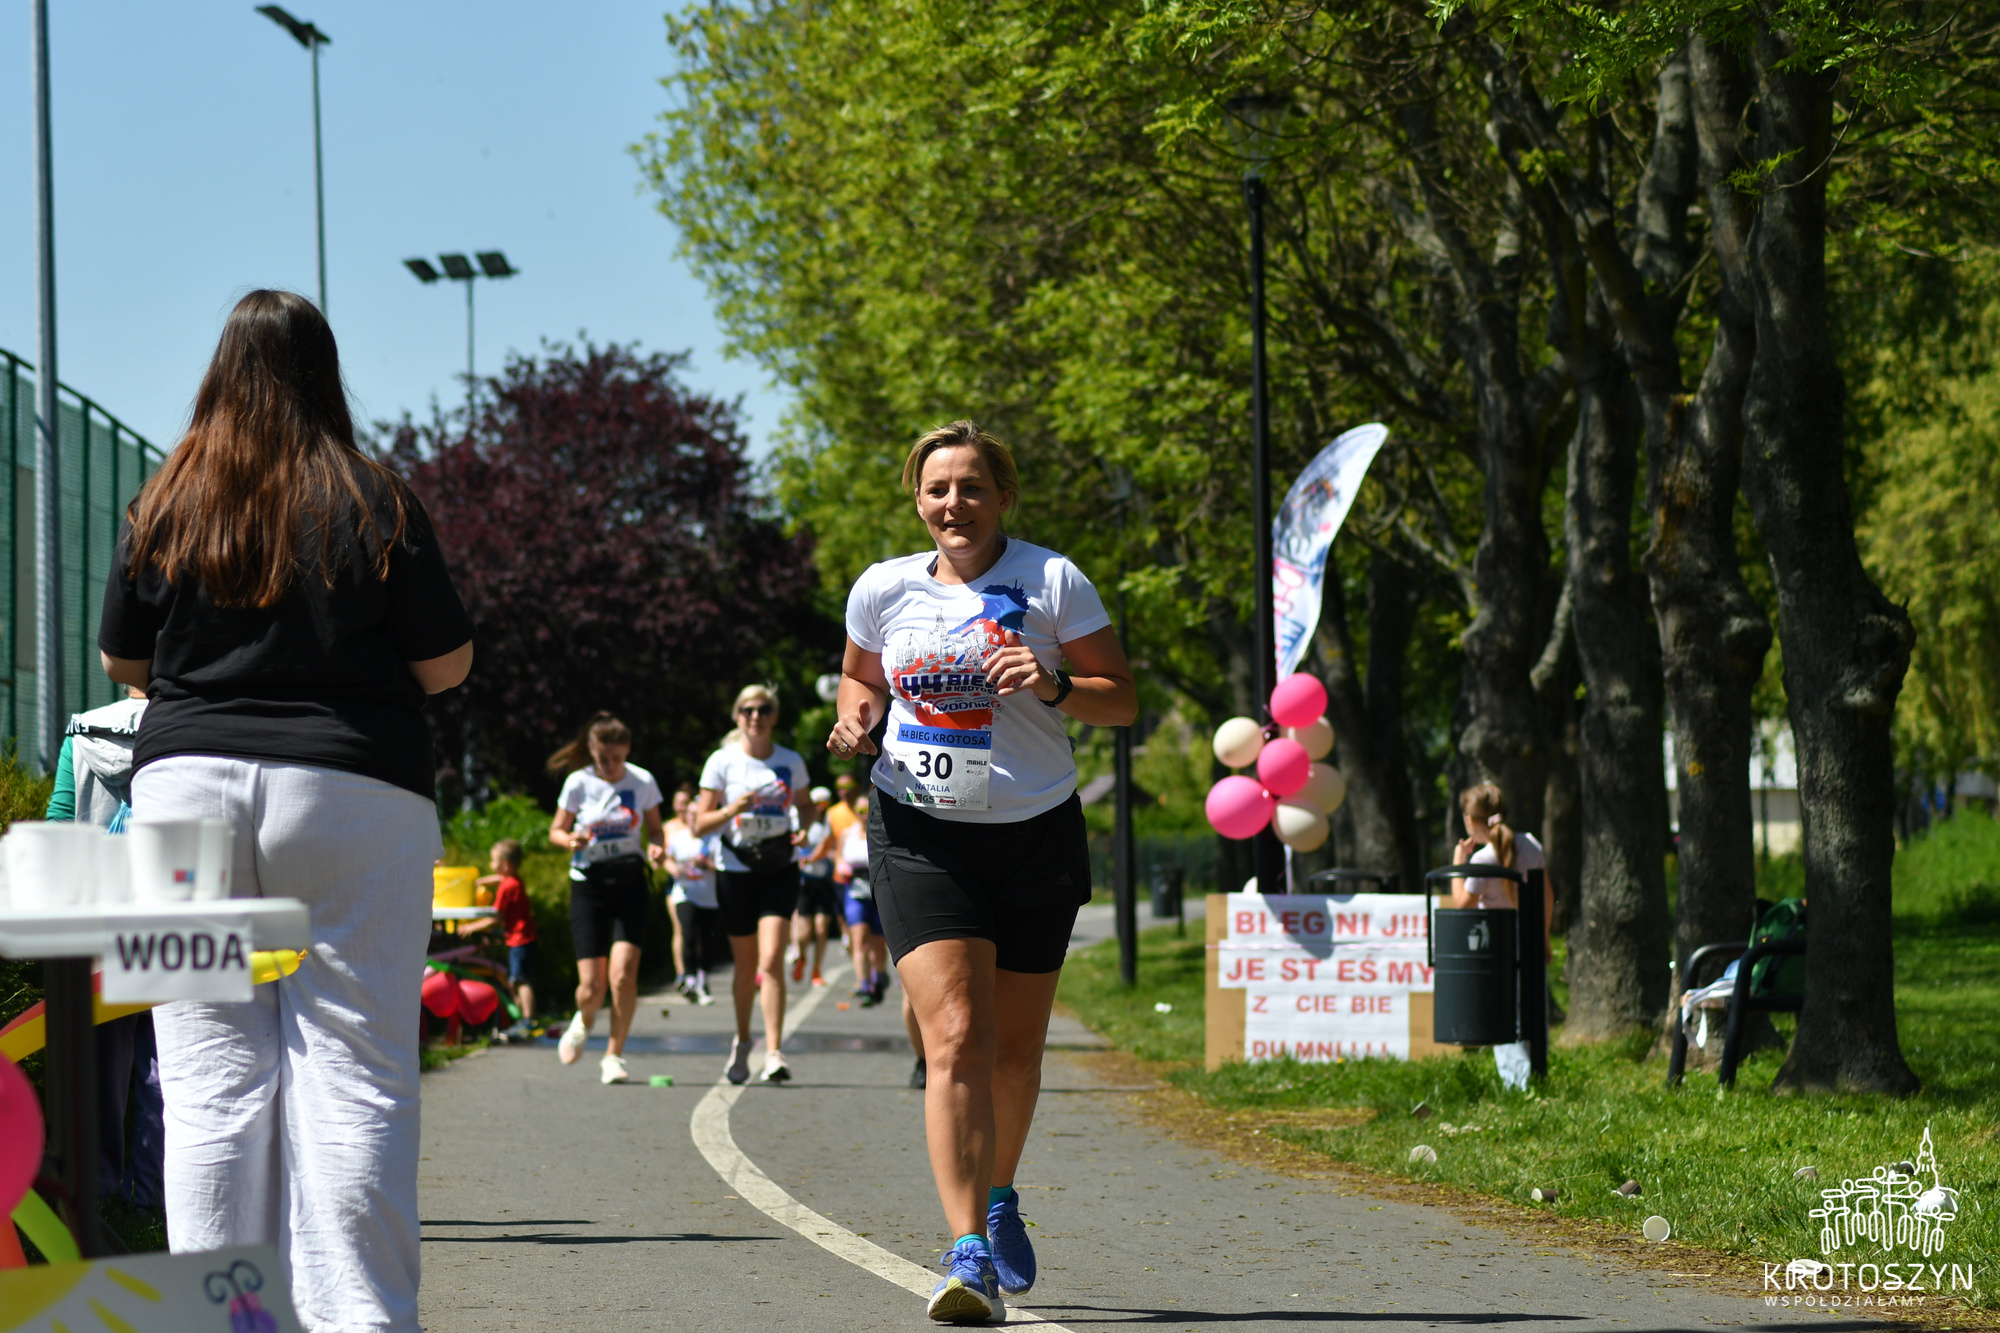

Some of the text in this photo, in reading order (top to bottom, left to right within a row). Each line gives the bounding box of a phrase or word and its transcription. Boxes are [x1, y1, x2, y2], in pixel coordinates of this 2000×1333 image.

[901, 675, 943, 697] 44
[910, 731, 930, 741] BIEG
[932, 733, 986, 746] KROTOSA
[916, 750, 953, 780] 30
[966, 759, 988, 767] MAHLE
[915, 782, 950, 793] NATALIA
[757, 818, 772, 831] 15
[603, 842, 620, 856] 16
[117, 932, 246, 971] WODA
[1252, 996, 1268, 1013] Z
